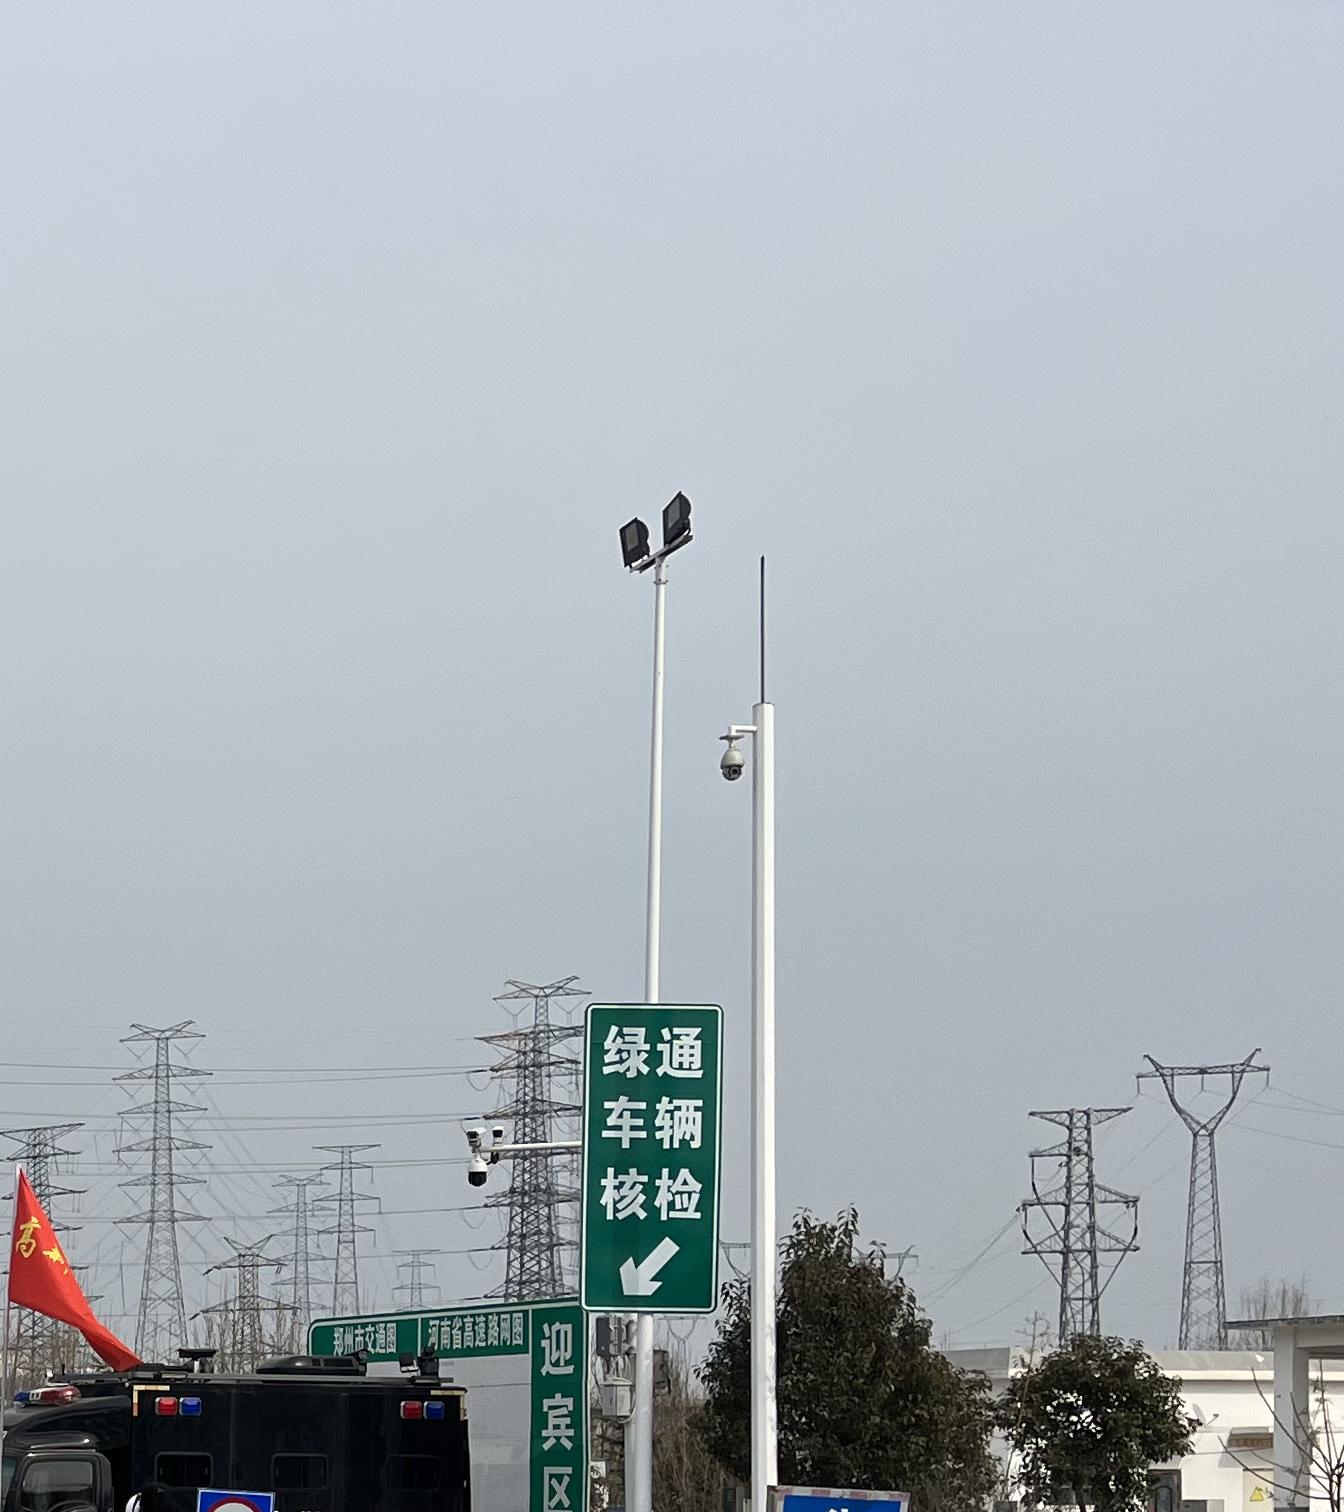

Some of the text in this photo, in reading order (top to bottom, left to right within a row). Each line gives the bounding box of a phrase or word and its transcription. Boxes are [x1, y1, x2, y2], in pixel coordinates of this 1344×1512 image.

[602, 1025, 704, 1079] 绿通
[601, 1095, 704, 1149] 车辆
[599, 1167, 703, 1221] 核检
[333, 1322, 397, 1357] 郑州市交通图
[427, 1312, 524, 1352] 河南省高速路网图
